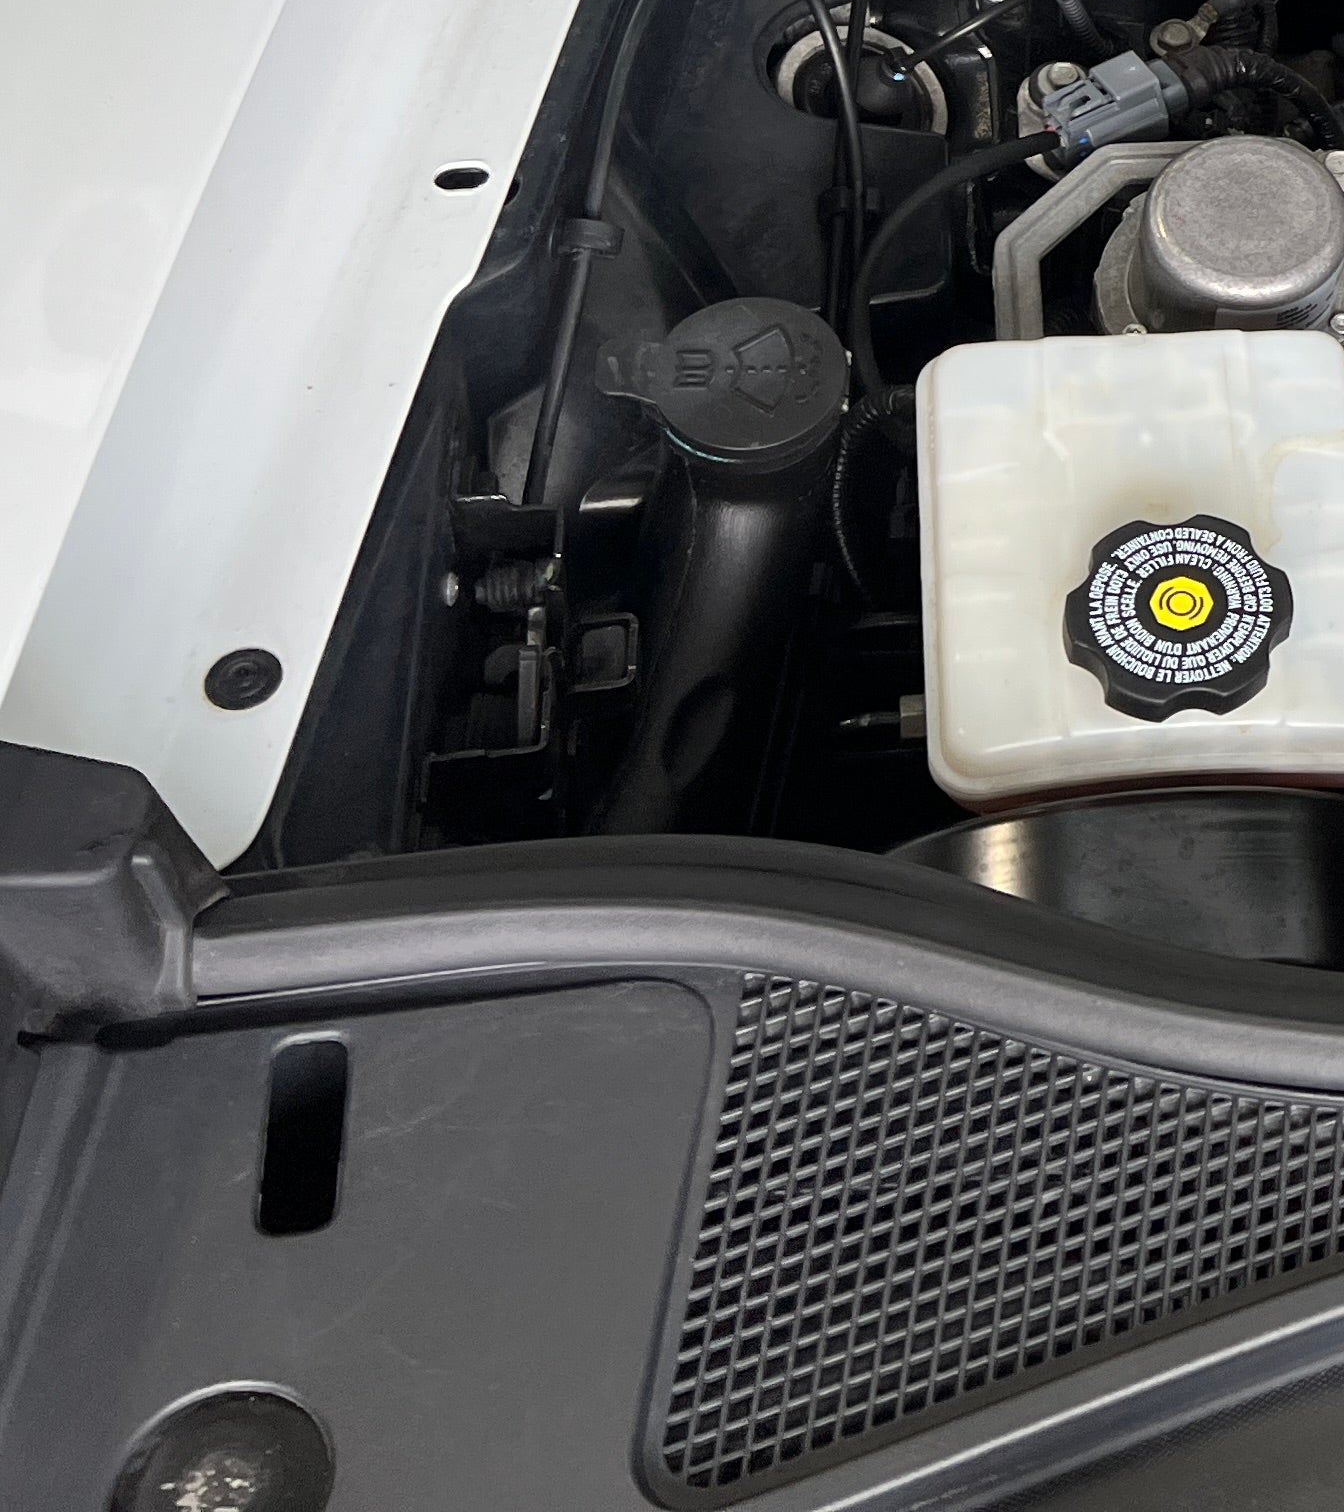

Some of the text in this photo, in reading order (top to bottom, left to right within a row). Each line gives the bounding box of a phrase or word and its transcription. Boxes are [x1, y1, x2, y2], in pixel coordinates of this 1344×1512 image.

[1174, 527, 1217, 543] SEALED
[1216, 535, 1226, 546] A
[1124, 549, 1150, 571] ONLY
[1148, 541, 1173, 557] USE
[1222, 539, 1253, 563] FROM
[1135, 554, 1174, 578] FILLER
[1175, 553, 1212, 569] CLEAN
[1106, 569, 1129, 594] DOT3
[1225, 558, 1256, 593] BEFORE
[1245, 560, 1269, 587] FLUID
[1089, 600, 1103, 615] LA
[1104, 595, 1122, 625] FREIN
[1243, 594, 1257, 612] CAP
[1258, 586, 1273, 612] DOT3
[1089, 617, 1115, 647] AVANT
[1110, 624, 1128, 640] DE
[1125, 618, 1156, 647] BIDON
[1186, 612, 1240, 655] PROVENANT
[1106, 644, 1156, 679] BOUCHON
[1119, 636, 1162, 666] LIQUIDE
[1161, 656, 1179, 669] DU
[1181, 655, 1206, 669] QUE
[1155, 669, 1172, 683] LE
[1174, 660, 1233, 683] NETTOYER
